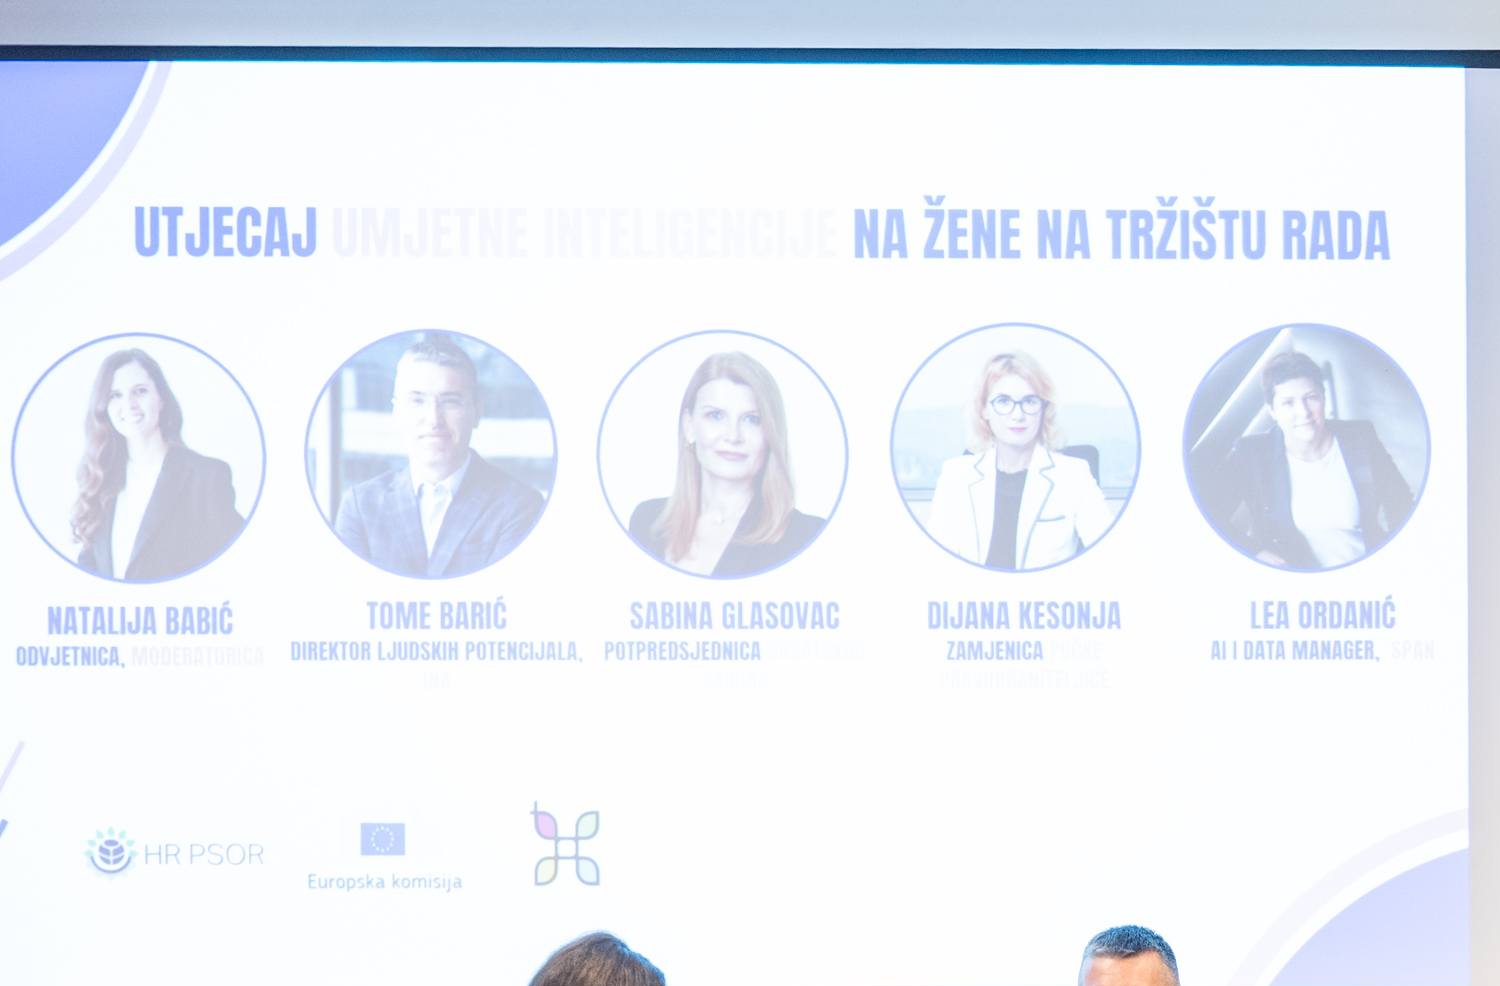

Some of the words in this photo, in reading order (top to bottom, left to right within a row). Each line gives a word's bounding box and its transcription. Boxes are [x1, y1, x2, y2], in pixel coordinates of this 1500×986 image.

[134, 205, 317, 258] UTJECAJ
[332, 208, 528, 259] UMJETNE
[853, 208, 909, 260] NA
[923, 194, 1022, 260] ŽENE
[1037, 208, 1091, 260] NA
[1105, 195, 1267, 261] TRŽIŠTU
[1282, 209, 1391, 261] RADA
[47, 605, 158, 636] NATALIJA
[165, 600, 233, 636] BABIĆ
[366, 600, 431, 630] TOME
[439, 595, 507, 630] BARIĆ
[630, 600, 713, 630] SABINA
[721, 600, 840, 630] GLASOVAC
[927, 600, 1011, 630] DIJANA
[1019, 600, 1122, 630] KESONJA
[1250, 600, 1290, 630] LEA
[1298, 594, 1396, 630] ORDANIĆ
[15, 645, 126, 669] ODVJETNICA,
[290, 640, 372, 662] DIREKTOR
[377, 640, 459, 662] LJUDSKIH
[464, 640, 583, 663] POTENCIJALA,
[604, 640, 761, 661] POTPREDSJEDNICA
[946, 640, 1044, 661] ZAMJENICA
[1210, 639, 1227, 661] AI
[1231, 639, 1238, 661] I
[1243, 639, 1287, 661] DATA
[1291, 639, 1381, 663] MANAGER,
[144, 843, 181, 865] HR
[189, 842, 264, 866] PSOR
[307, 872, 386, 893] Europska
[391, 872, 463, 894] komisija
